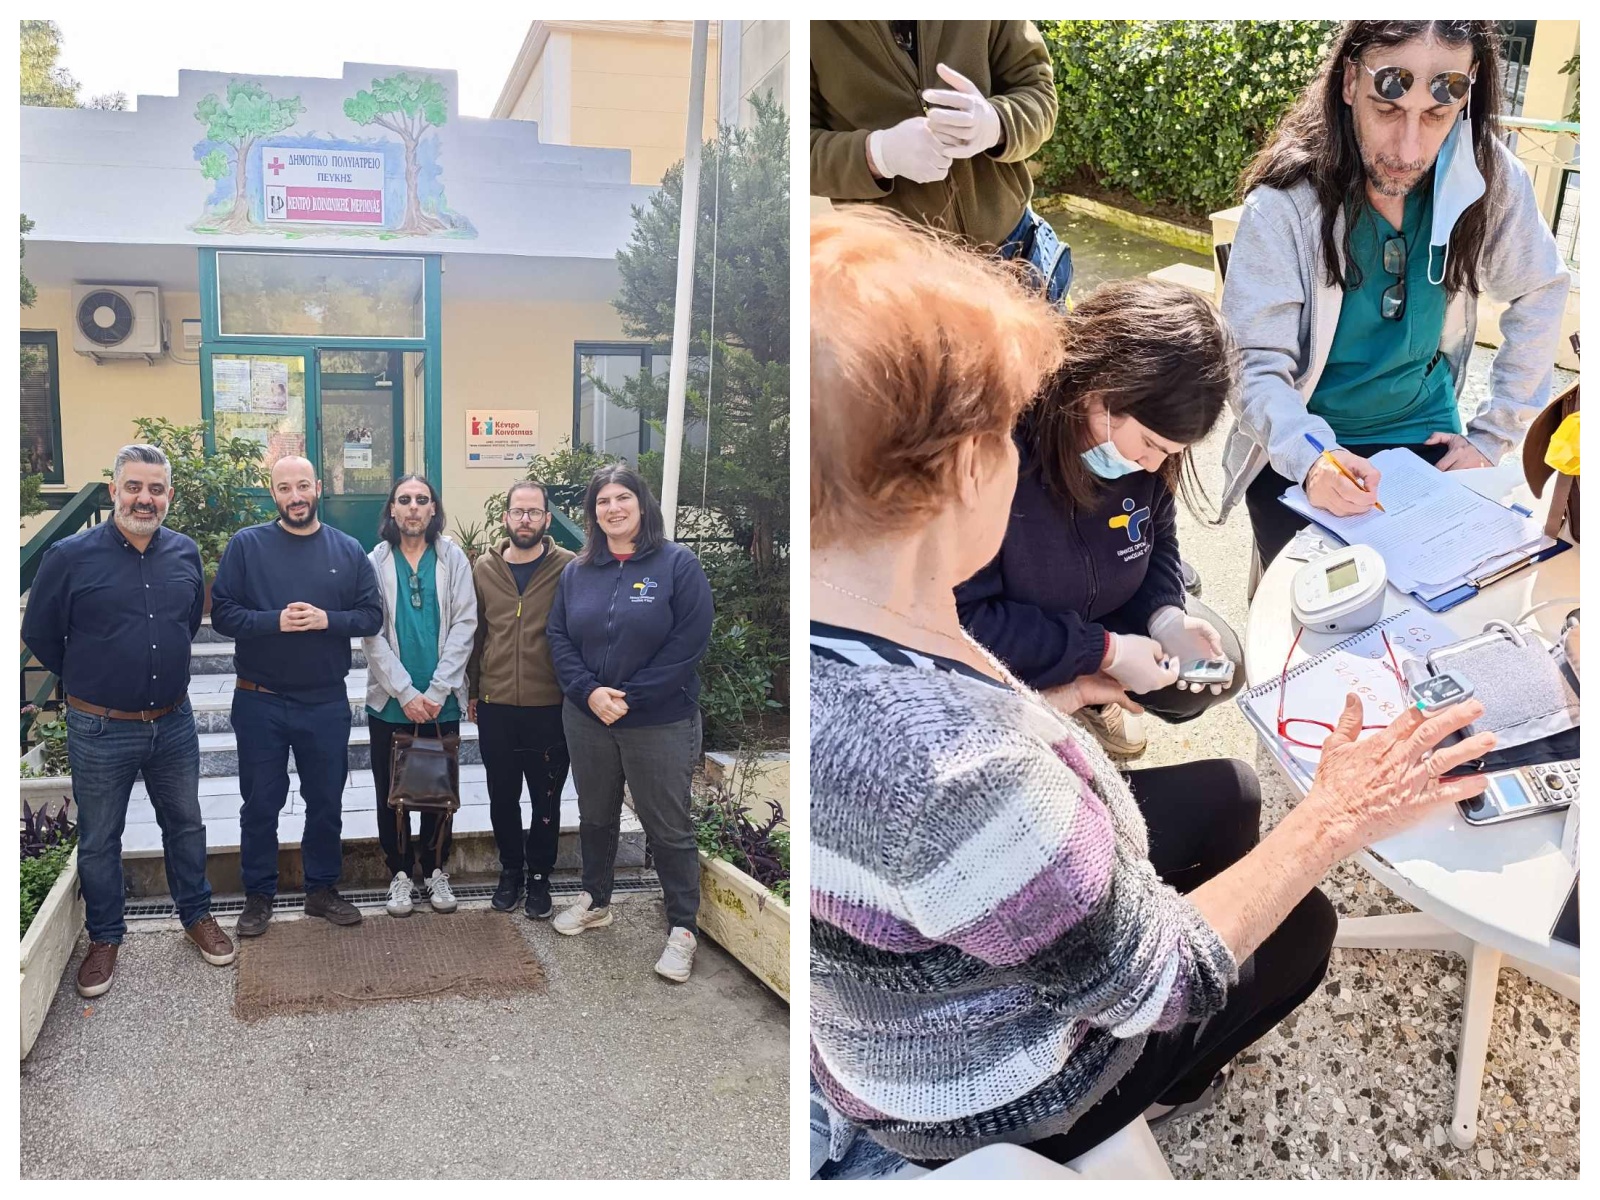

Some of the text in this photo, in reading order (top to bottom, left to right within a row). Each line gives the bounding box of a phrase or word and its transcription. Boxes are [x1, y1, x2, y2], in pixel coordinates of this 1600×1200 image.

[288, 154, 381, 170] ΔΗΜΟΤΙΚΟ ΠΟΛΥΙΑΤΡΕΙΟ
[317, 172, 353, 183] ΠΕΥΚΗΣ
[495, 421, 520, 430] Κέντρο
